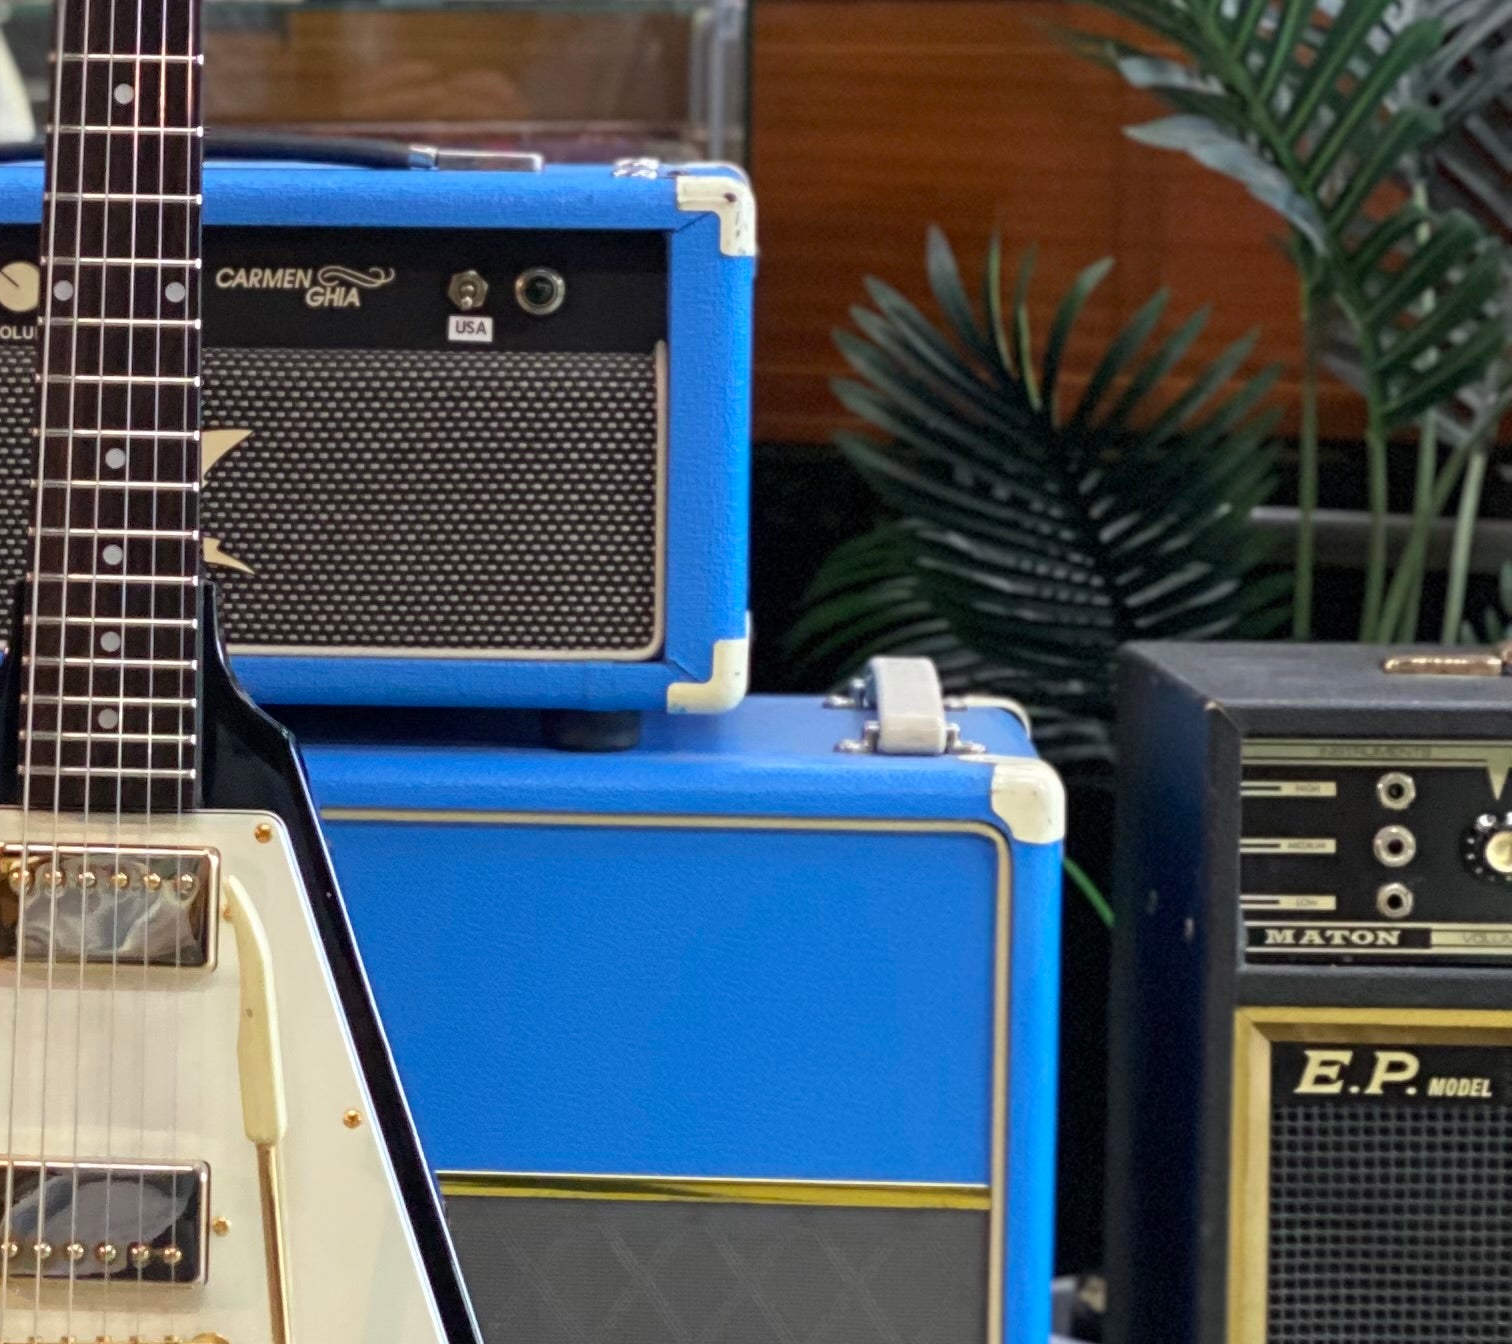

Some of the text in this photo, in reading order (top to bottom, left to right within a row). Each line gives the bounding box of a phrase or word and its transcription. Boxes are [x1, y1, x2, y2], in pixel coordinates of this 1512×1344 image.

[215, 267, 314, 289] CARMEN
[304, 287, 361, 308] GHIA
[454, 320, 487, 335] USA
[1264, 928, 1401, 946] MATON
[1293, 1049, 1493, 1098] E.P. MODEL
